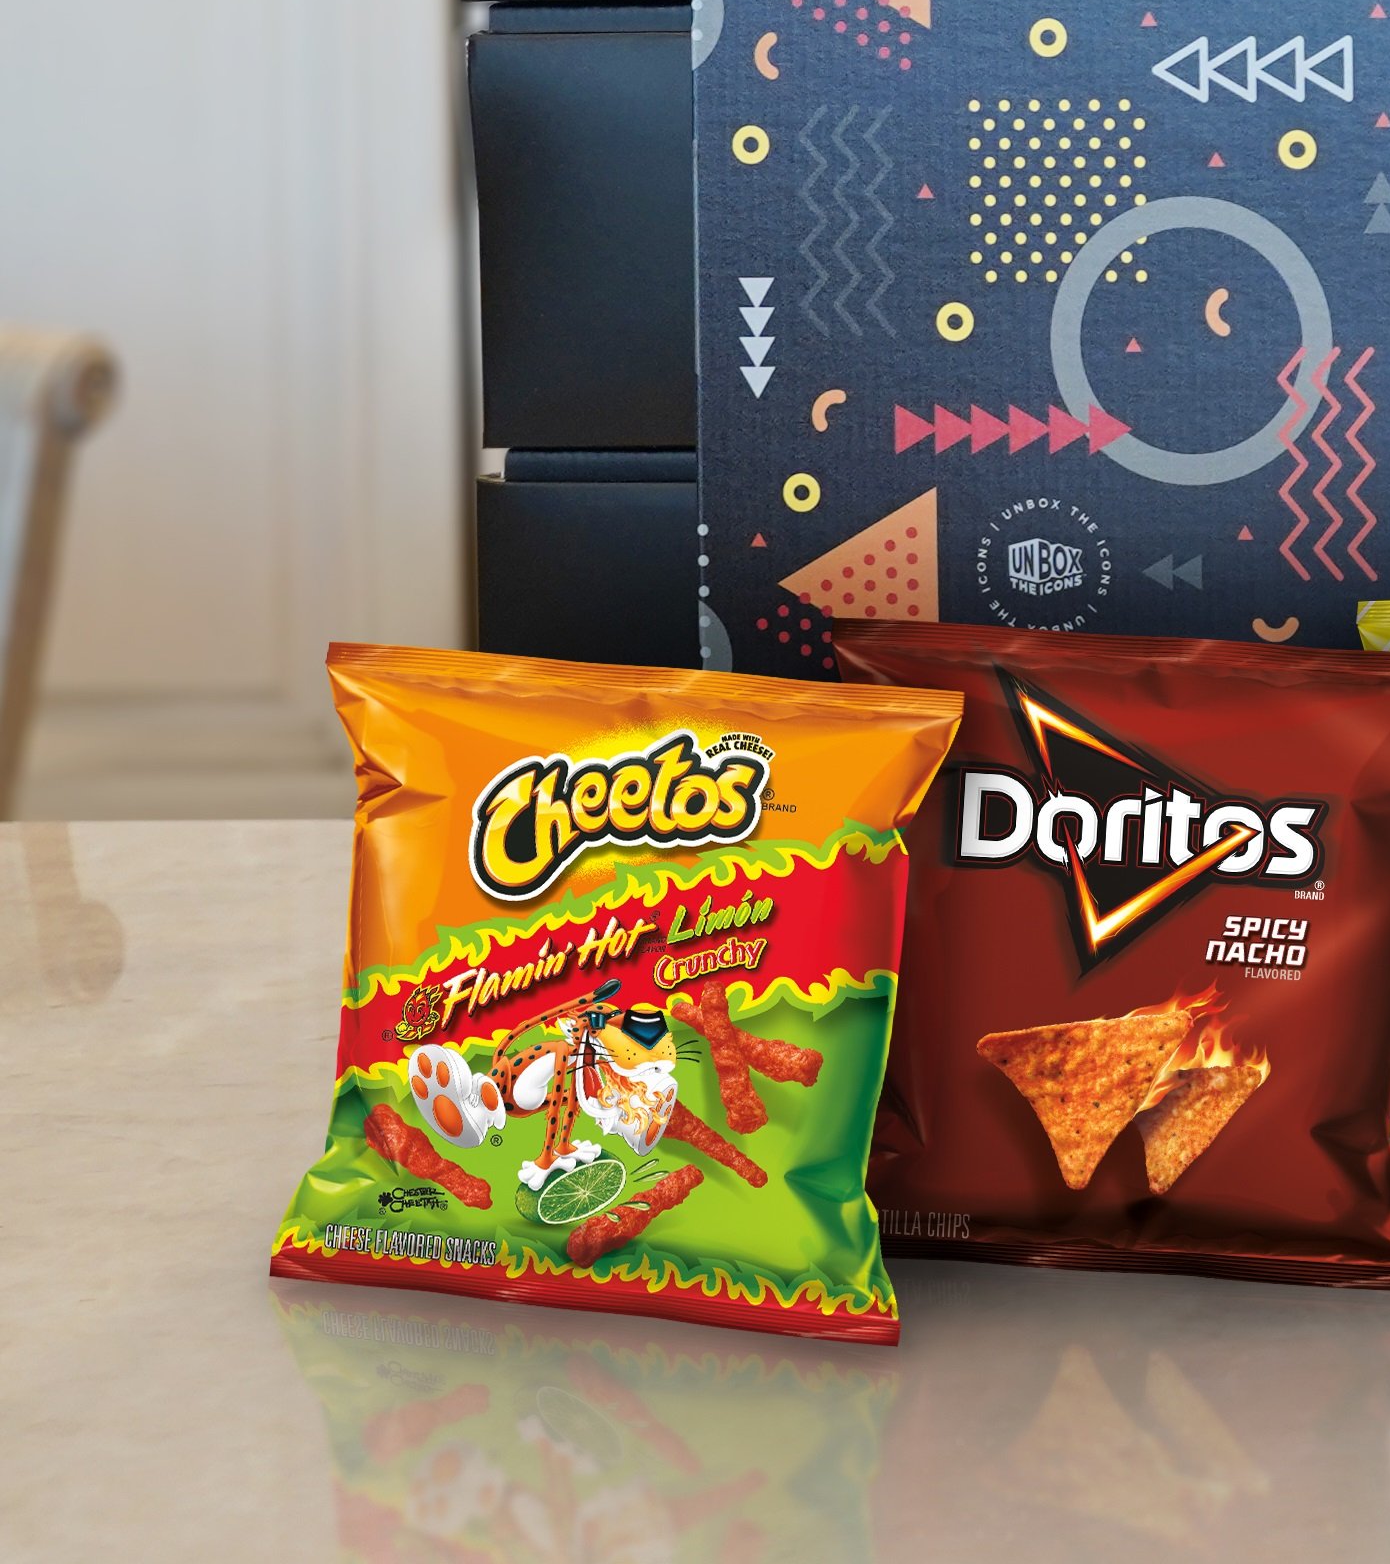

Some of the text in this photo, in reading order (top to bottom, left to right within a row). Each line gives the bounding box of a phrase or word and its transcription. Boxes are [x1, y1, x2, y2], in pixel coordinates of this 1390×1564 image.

[976, 536, 992, 593] ICONS
[1001, 497, 1112, 597] UNBOX THE ICONS
[1008, 537, 1083, 584] UNBOX
[1009, 574, 1084, 596] THE ICONS
[705, 740, 774, 761] REAL CHEESE!
[721, 733, 761, 744] MADE WITH
[476, 736, 763, 894] Cheetos
[761, 802, 797, 814] BRAND
[959, 770, 1319, 875] Doritos
[1294, 890, 1325, 901] BRAND
[666, 889, 775, 945] Limón
[1222, 915, 1309, 942] SPICY
[576, 915, 660, 970] Hot
[1205, 939, 1307, 967] NACHO
[654, 936, 768, 989] Crunchy
[1244, 967, 1302, 981] FLAVORED
[927, 1211, 971, 1240] CHIPS
[324, 1222, 497, 1266] CHEESE FLAVORED SNACKS
